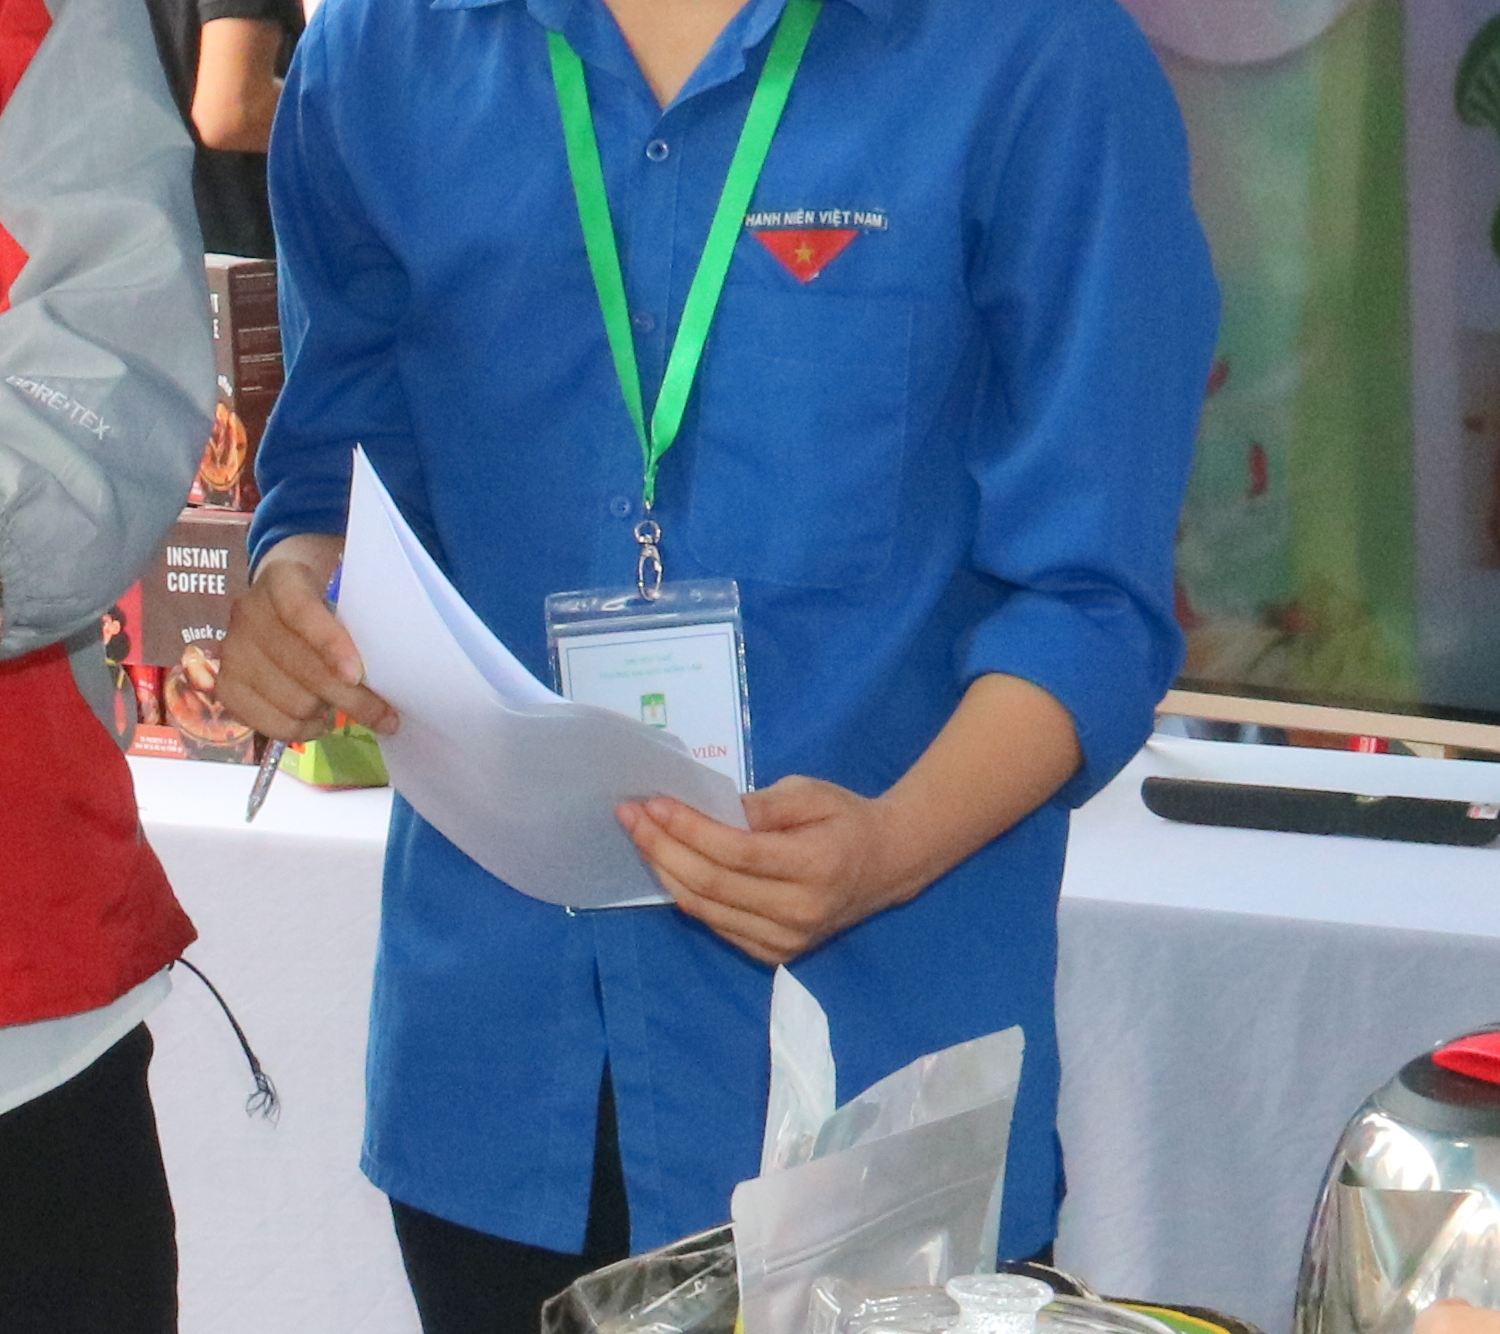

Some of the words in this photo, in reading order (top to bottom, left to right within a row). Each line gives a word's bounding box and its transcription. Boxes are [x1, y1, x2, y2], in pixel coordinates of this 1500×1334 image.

[744, 212, 781, 227] HANH
[783, 207, 815, 225] NIÊN
[819, 208, 851, 228] VIỆT
[854, 211, 882, 227] NAM
[166, 545, 229, 570] INSTANT
[167, 571, 226, 595] COFFEE
[181, 623, 213, 646] Black
[692, 744, 727, 759] VIÊN
